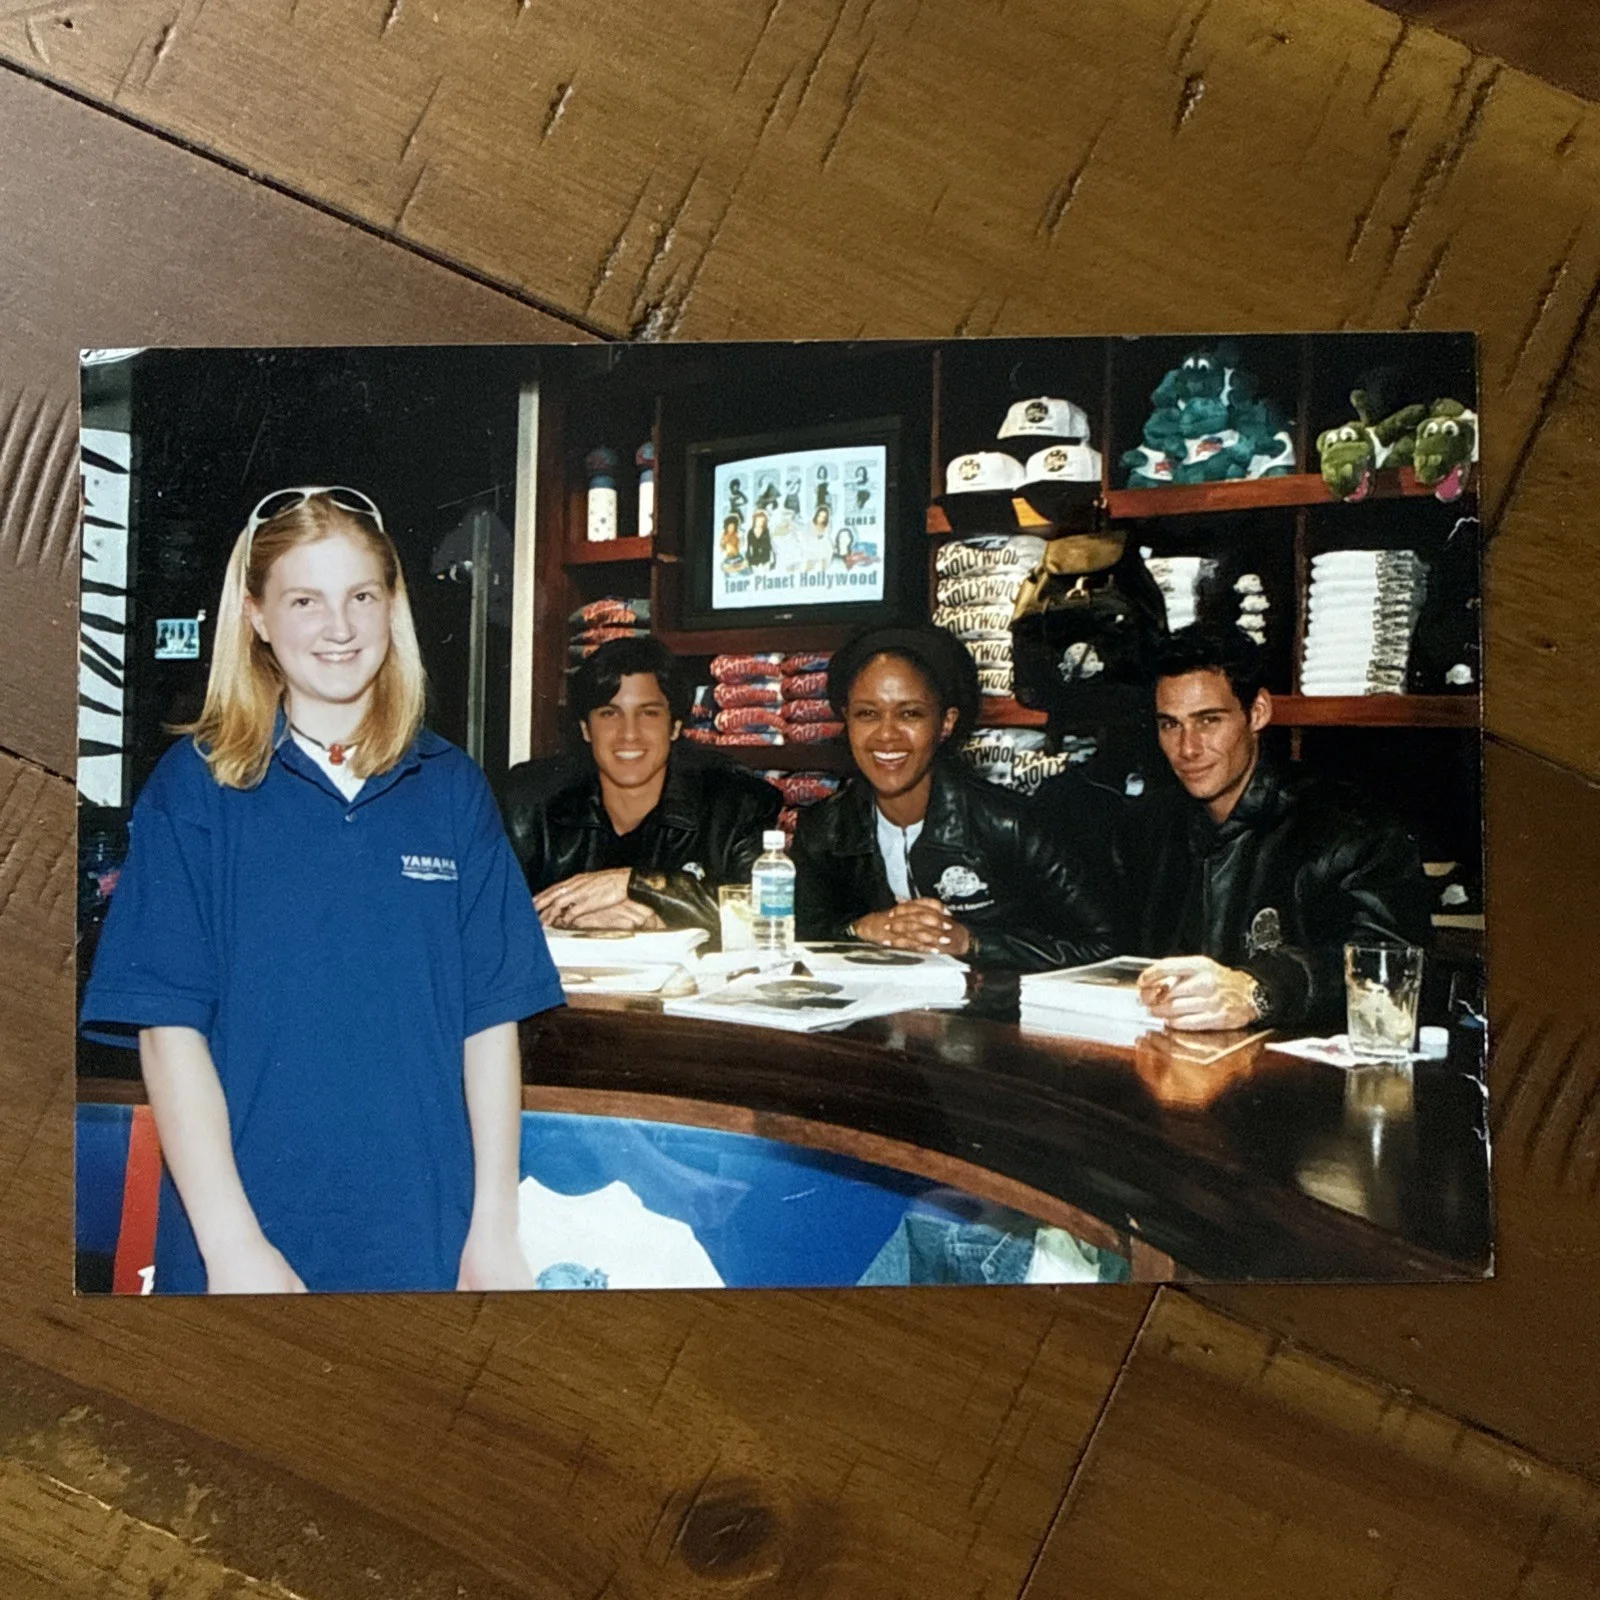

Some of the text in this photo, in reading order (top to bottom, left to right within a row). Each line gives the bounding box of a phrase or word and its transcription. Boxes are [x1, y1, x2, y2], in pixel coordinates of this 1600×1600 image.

[755, 574, 795, 591] Planet
[801, 569, 878, 590] Hollywood
[400, 855, 457, 870] YAMAHA
